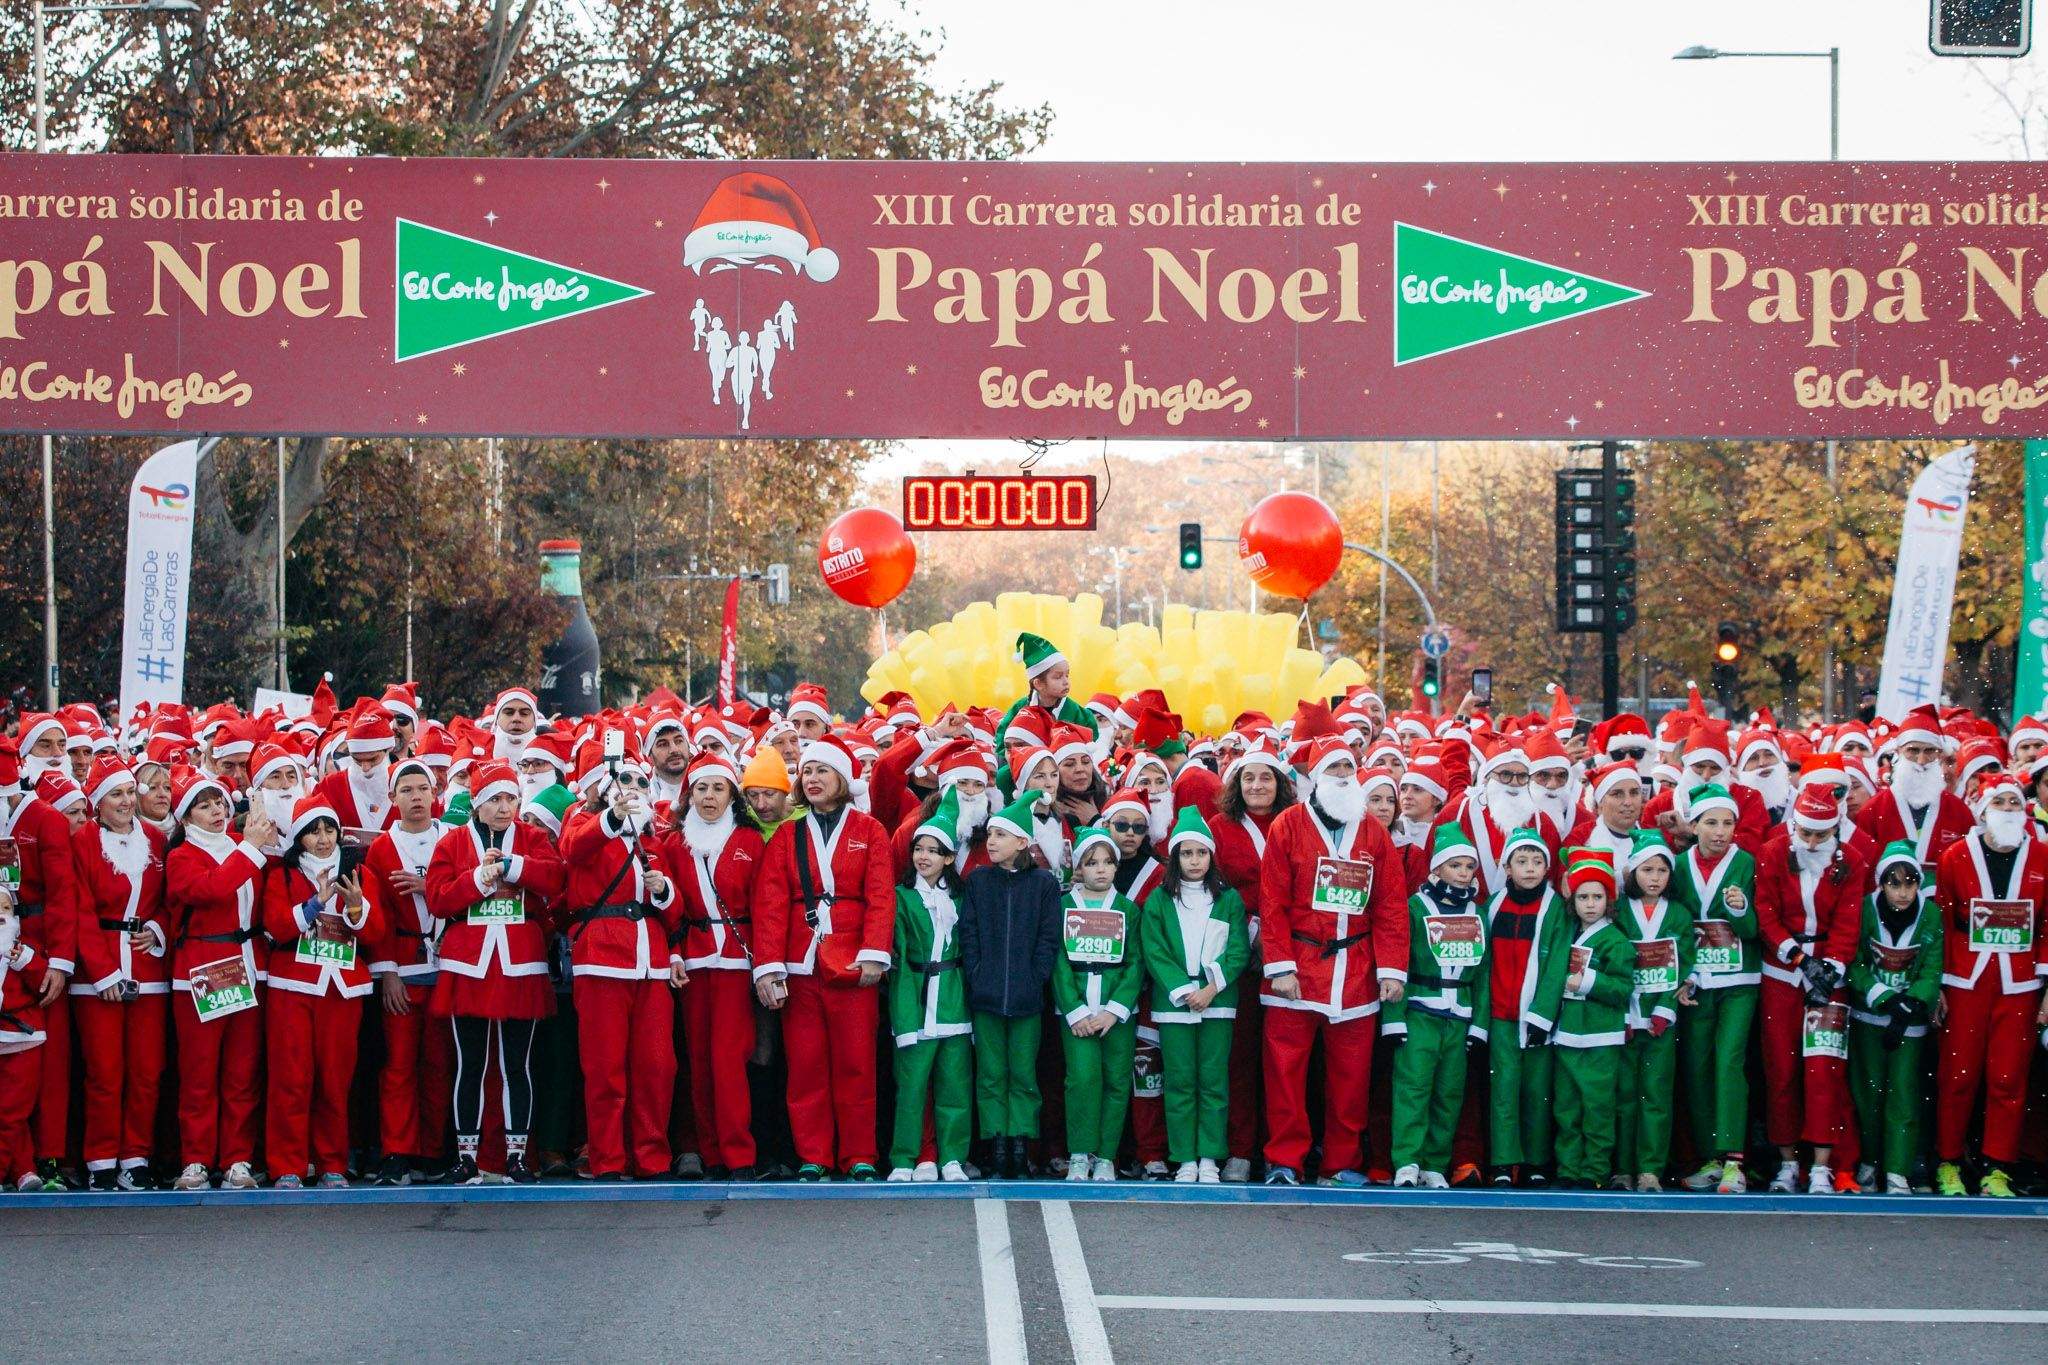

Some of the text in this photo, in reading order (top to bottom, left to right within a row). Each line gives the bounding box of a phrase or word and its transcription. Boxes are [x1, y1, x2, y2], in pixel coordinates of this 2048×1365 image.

[0, 188, 364, 222] arrera solidaria de
[872, 192, 1363, 227] XIII Carrera solidaria de
[1686, 192, 2048, 226] XIII Carrera solid
[0, 235, 368, 340] pá Noel
[403, 265, 590, 312] El Corte Inglés
[867, 242, 1367, 348] Papá Noel
[1401, 268, 1588, 314] El Corte Inglés
[1681, 241, 1930, 348] Papá
[20, 361, 113, 403] Corte
[117, 353, 253, 419] Inglés
[978, 359, 1253, 426] El Corte Inglés
[1793, 359, 2048, 425] El Corte Inglé
[908, 480, 1088, 526] 00:00:00
[479, 899, 514, 916] 4456
[1326, 886, 1362, 907] 6424
[1075, 936, 1113, 954] 2890
[1439, 942, 1474, 958] 2888
[1983, 928, 2021, 944] 6706
[1696, 948, 1730, 964] 5303
[1632, 967, 1668, 985] 5302
[206, 986, 244, 1010] 3404
